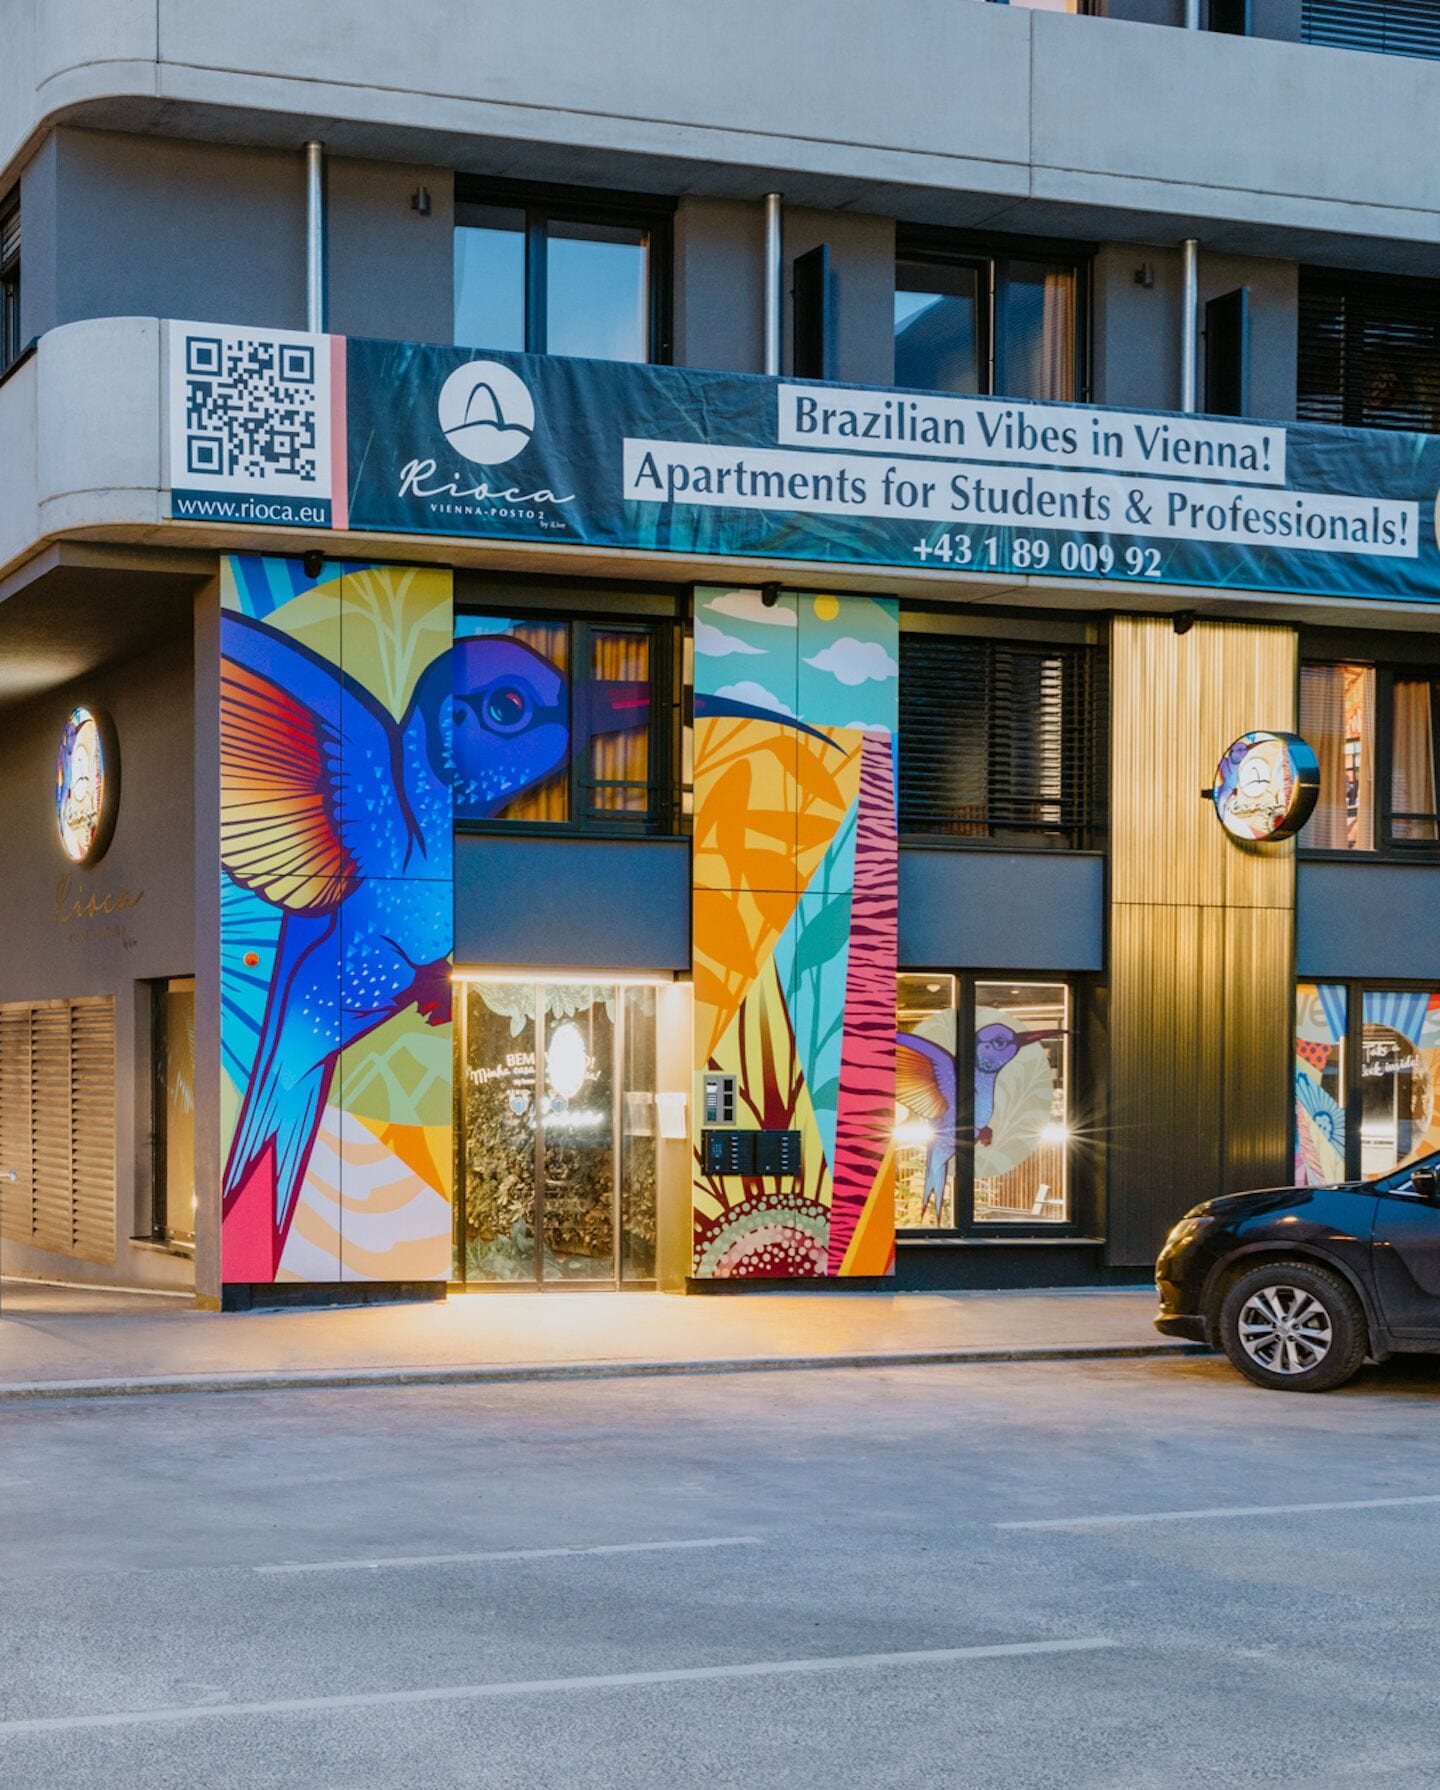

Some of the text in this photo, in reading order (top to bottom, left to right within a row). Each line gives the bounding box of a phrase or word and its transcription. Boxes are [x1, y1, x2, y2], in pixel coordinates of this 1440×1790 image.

[796, 396, 1270, 472] Brazilian Vibes in Vienna!
[398, 459, 575, 504] Rioca
[634, 451, 1408, 546] Apartments for Students & Professionals!
[177, 498, 325, 523] www.rioca.eu
[430, 504, 535, 519] VIENNA-POSTO
[913, 533, 1161, 577] +43 1 89 009 92
